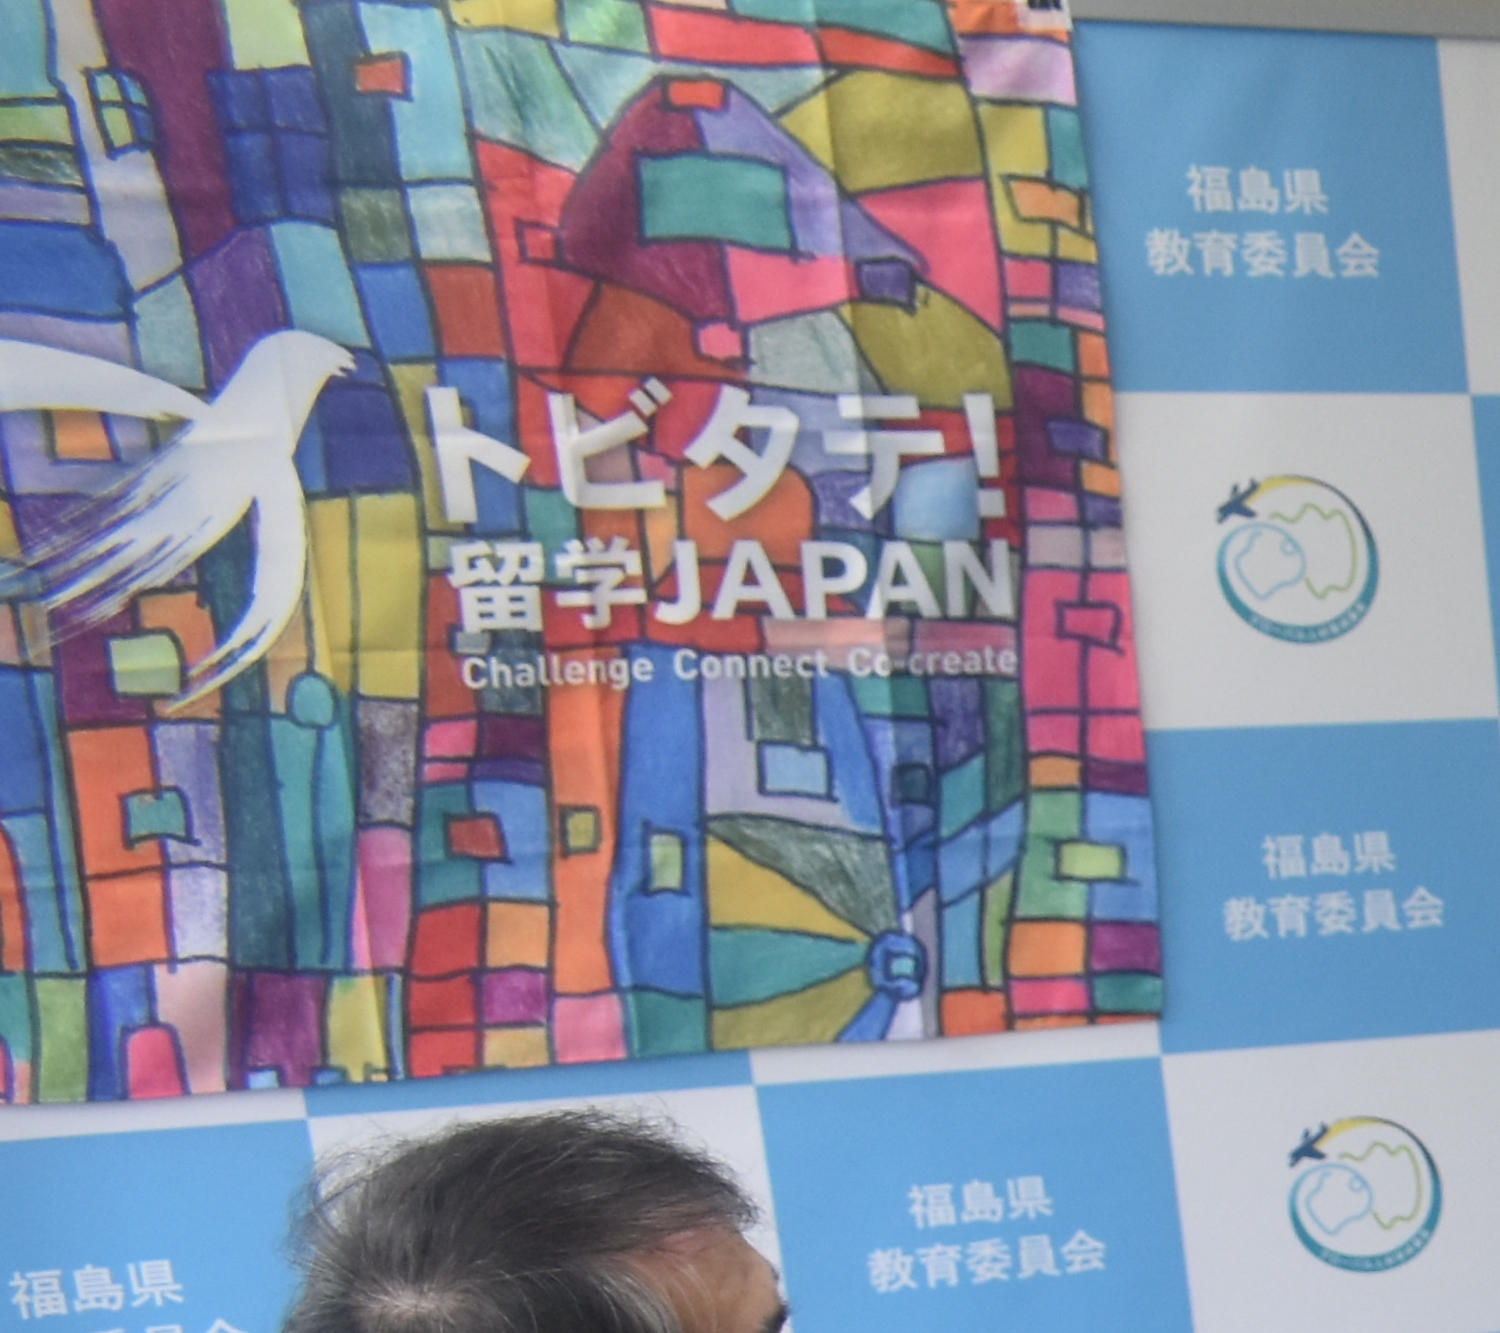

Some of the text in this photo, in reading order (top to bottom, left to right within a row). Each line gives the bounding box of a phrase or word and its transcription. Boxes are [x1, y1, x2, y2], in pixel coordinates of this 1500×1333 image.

[1187, 164, 1328, 216] 福島県
[1146, 230, 1381, 280] 教育委員会
[427, 378, 1005, 523] トビタテ!
[448, 539, 1014, 634] 留学JAPAN
[462, 644, 1017, 692] Challenge Connect Co-create
[1261, 832, 1395, 879] 福島県
[1223, 887, 1445, 942] 教育委員会
[908, 1176, 1054, 1228] 福島県
[867, 1230, 1107, 1293] 教育委員会
[10, 1259, 184, 1320] 福島県
